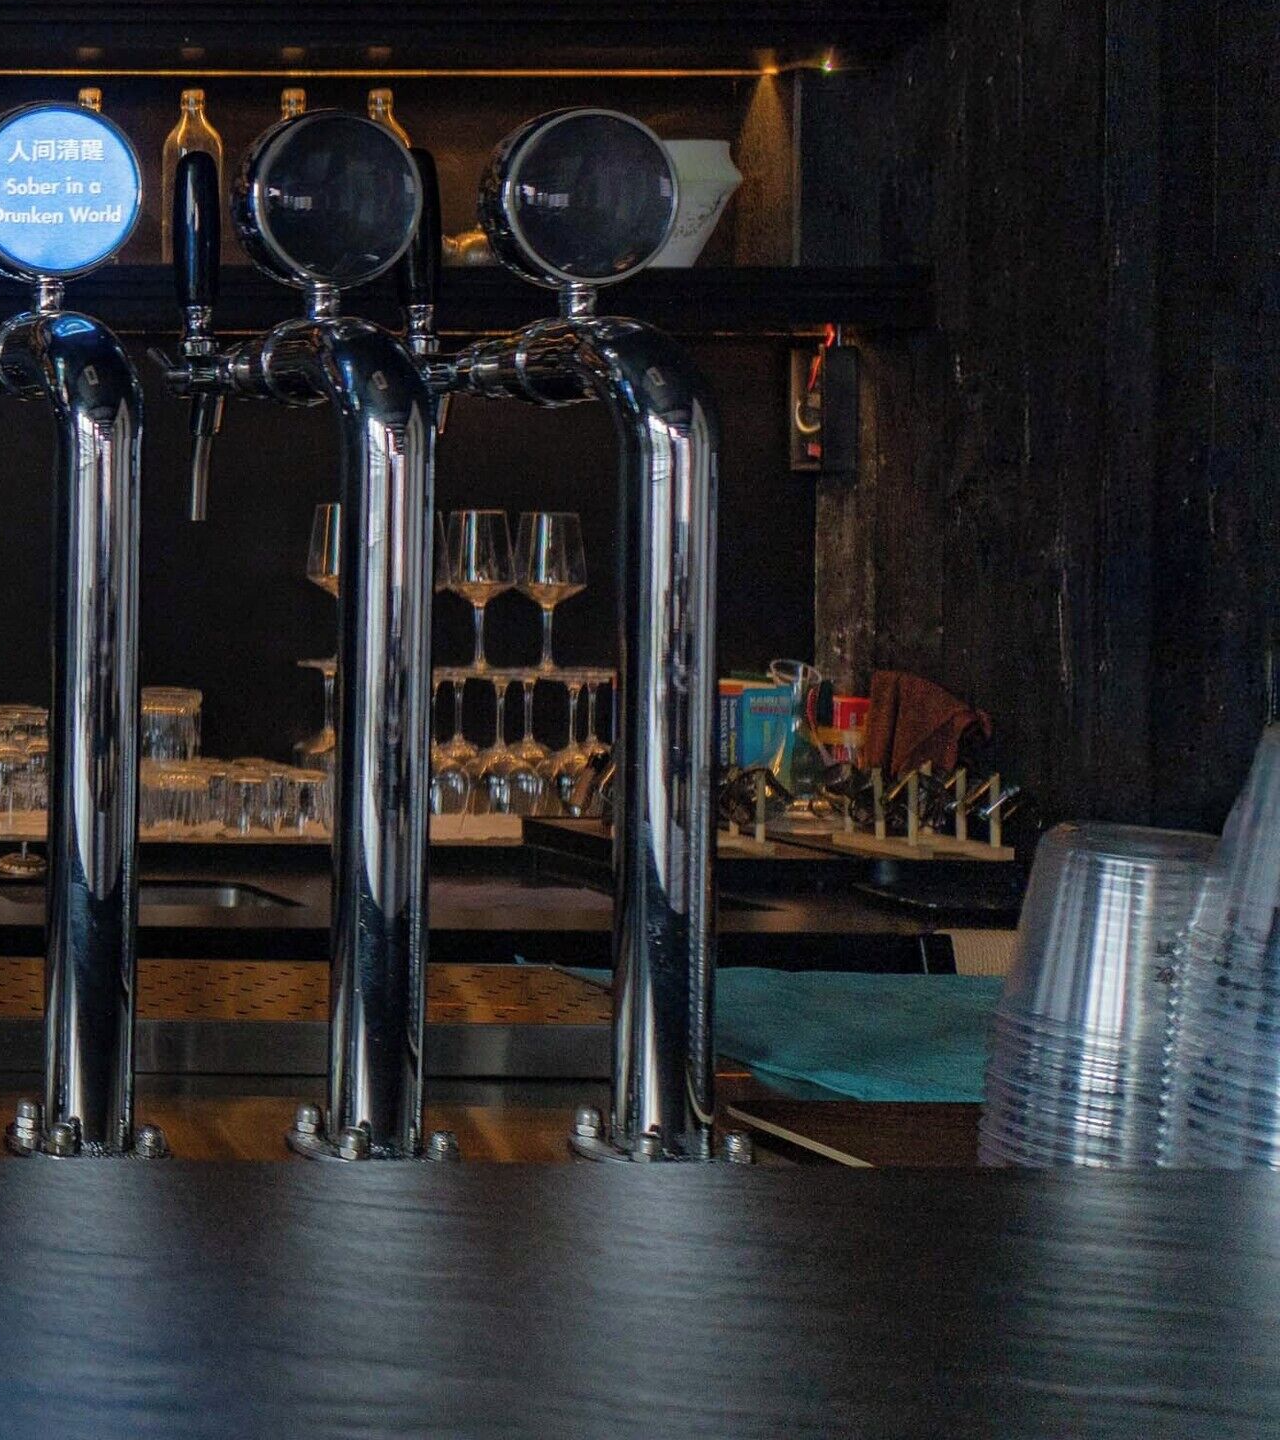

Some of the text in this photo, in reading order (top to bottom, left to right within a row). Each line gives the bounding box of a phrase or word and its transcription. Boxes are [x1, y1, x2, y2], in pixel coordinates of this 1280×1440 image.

[7, 139, 105, 163] 人间清醒
[6, 176, 102, 196] Sober in a
[69, 204, 122, 224] World
